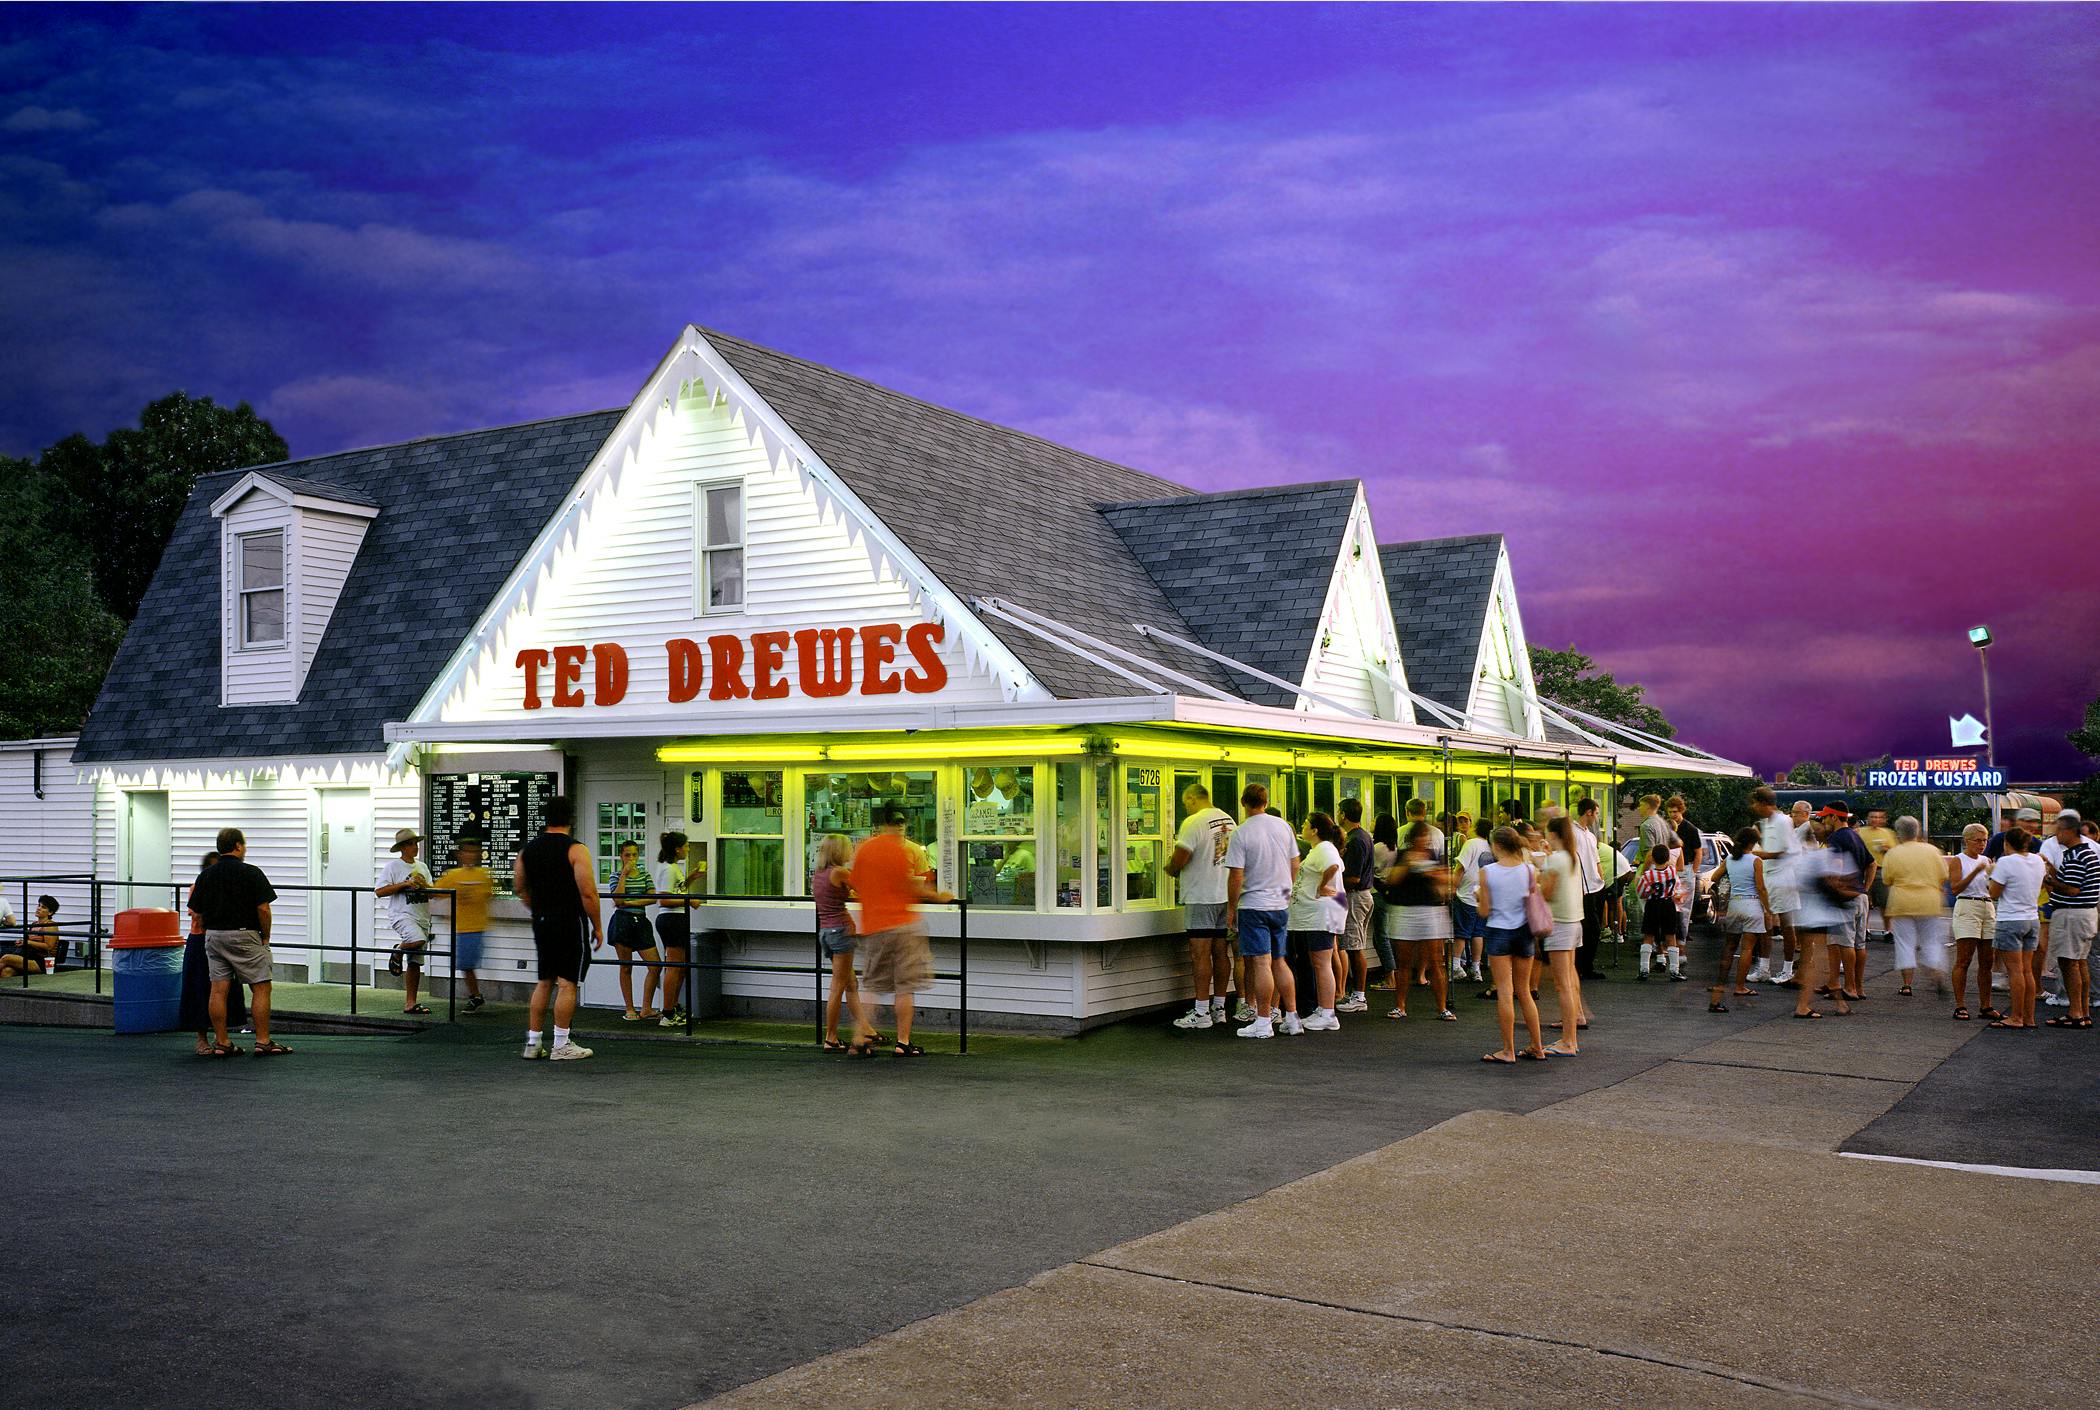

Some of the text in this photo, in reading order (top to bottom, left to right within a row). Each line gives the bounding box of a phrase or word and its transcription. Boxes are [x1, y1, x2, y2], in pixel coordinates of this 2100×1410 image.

[516, 623, 948, 710] TED DREWES
[1893, 759, 1977, 771] TED DREWES
[1140, 769, 1160, 785] 6726
[1869, 771, 2002, 787] FROZEN-CUSTARD
